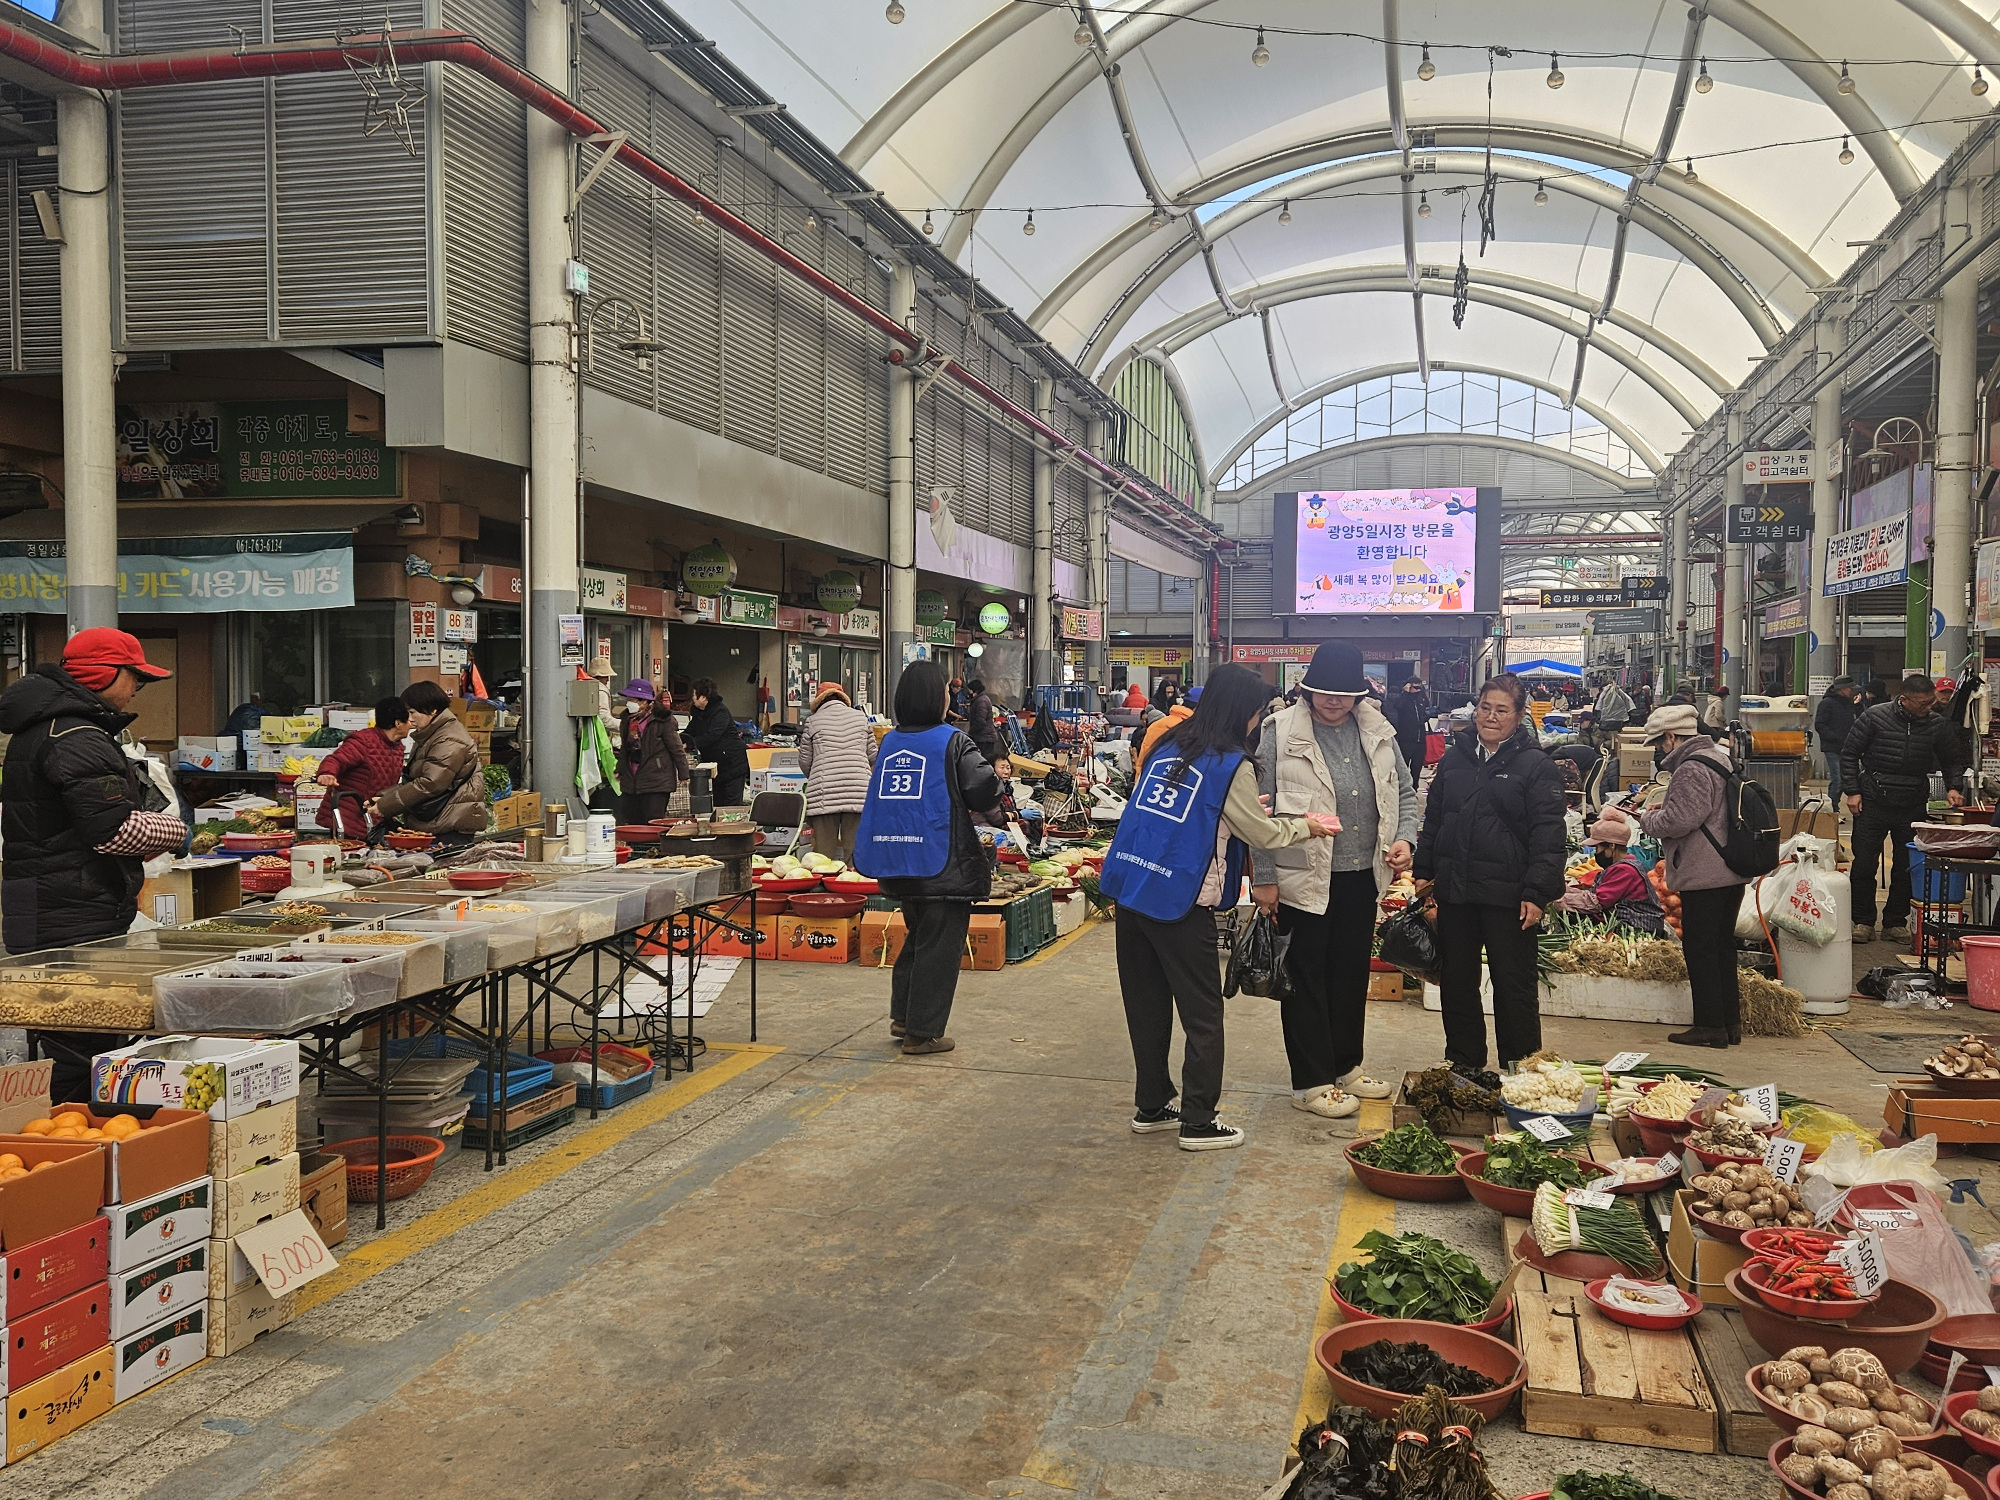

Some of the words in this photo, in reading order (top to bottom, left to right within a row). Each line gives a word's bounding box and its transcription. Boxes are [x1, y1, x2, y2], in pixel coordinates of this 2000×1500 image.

[237, 416, 270, 443] 각종
[276, 414, 309, 442] 야채
[1770, 467, 1808, 476] 고객쉼터
[1327, 524, 1407, 540] 광양5일시장
[1412, 523, 1455, 538] 방문을
[1739, 526, 1800, 538] 고객쉼터
[1869, 526, 1886, 549] 공사로
[1887, 519, 1904, 544] 인하여
[1356, 544, 1428, 560] 환영합니다
[688, 565, 724, 578] 정일상회
[1837, 557, 1852, 579] 불편을
[135, 569, 183, 599] 카드
[188, 569, 287, 598] 사용가능
[293, 566, 341, 595] 매장
[1333, 574, 1354, 586] 새해
[1357, 574, 1368, 586] 복
[1371, 573, 1392, 586] 많이
[1395, 573, 1439, 586] 받으세요
[413, 610, 435, 623] 할인
[449, 614, 461, 627] 86
[413, 625, 435, 637] 쿠폰
[890, 775, 912, 793] 33
[1147, 783, 1179, 808] 33
[111, 1063, 163, 1082] 쌍무지개
[161, 1083, 183, 1099] 포도
[1857, 1238, 1880, 1290] 5,000원
